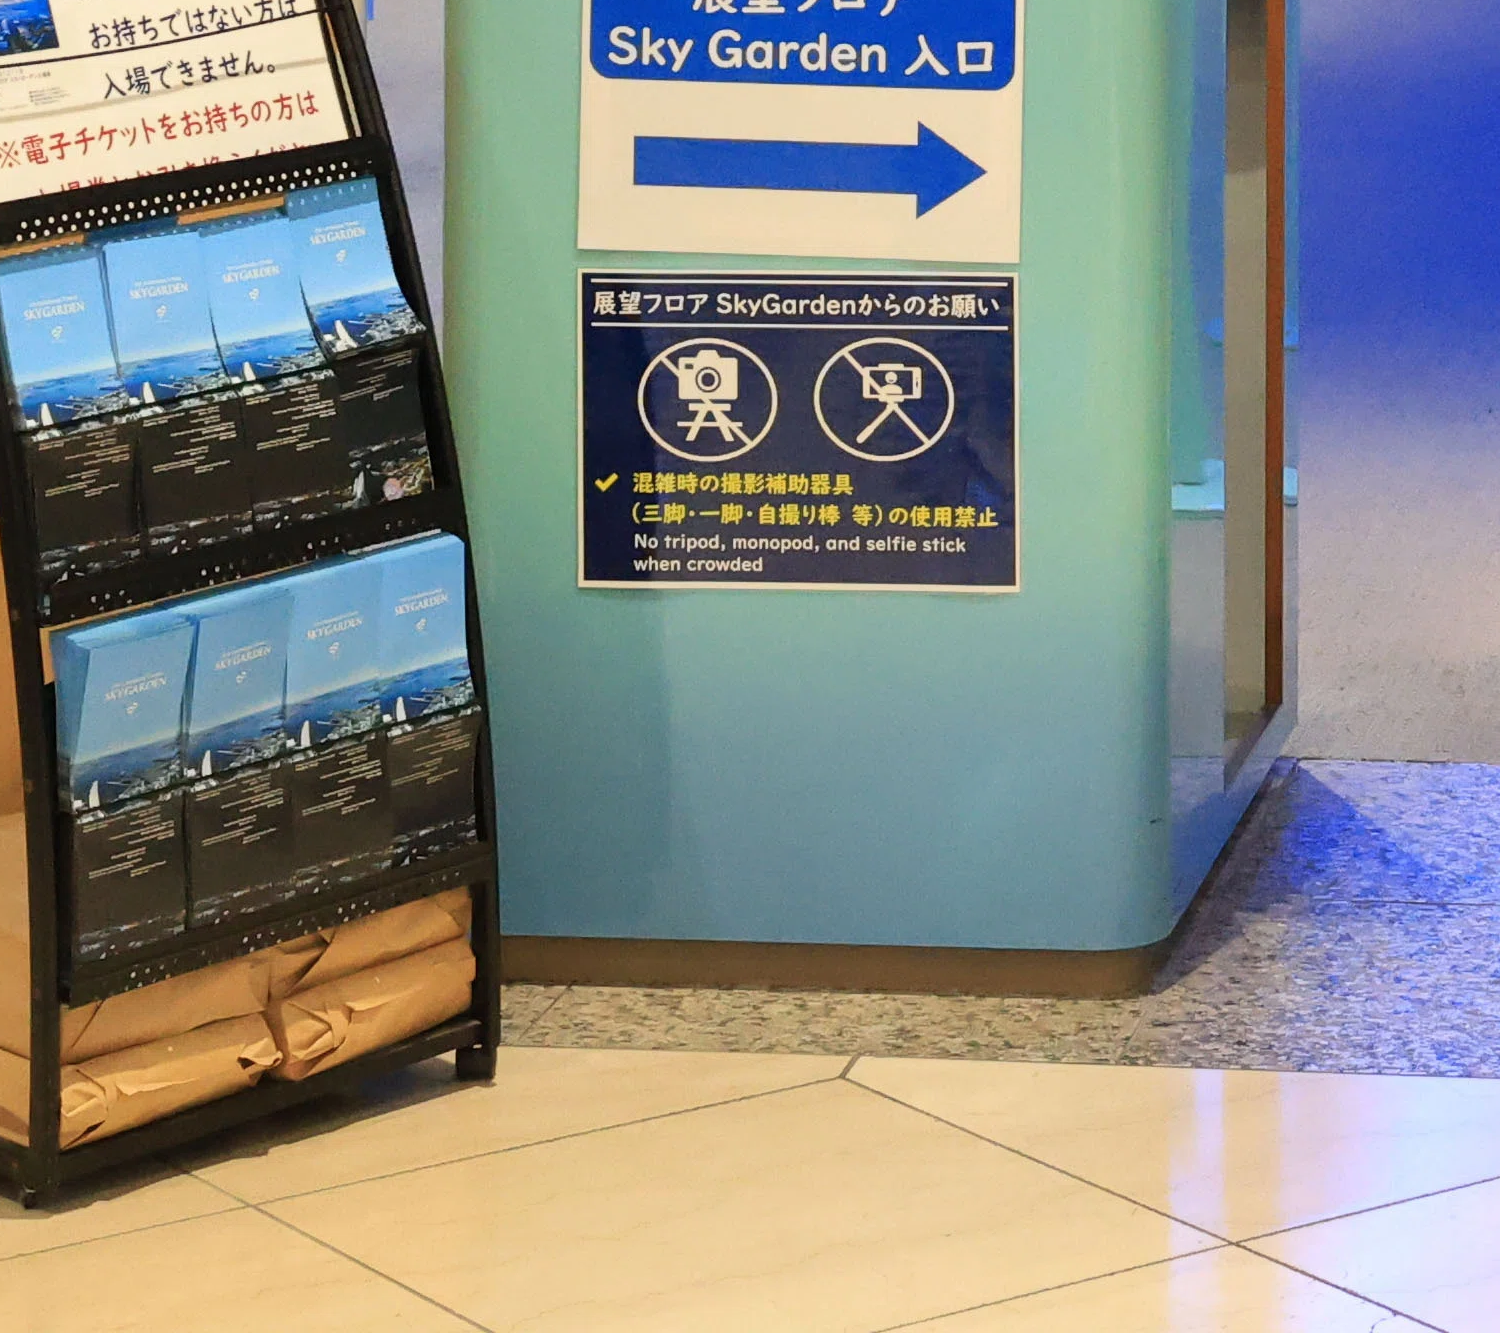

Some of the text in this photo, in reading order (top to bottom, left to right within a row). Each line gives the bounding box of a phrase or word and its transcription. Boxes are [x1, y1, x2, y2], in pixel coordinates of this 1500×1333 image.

[608, 25, 995, 75] Sky Garden 入口
[103, 49, 278, 99] 入場できません。
[593, 291, 1000, 318] 展望フロア SkyGardenからのお願い
[633, 473, 854, 495] 混雑時の撮影補助器具
[634, 534, 966, 554] No tripod, monopod, and selfie stick
[634, 555, 763, 573] when crowded
